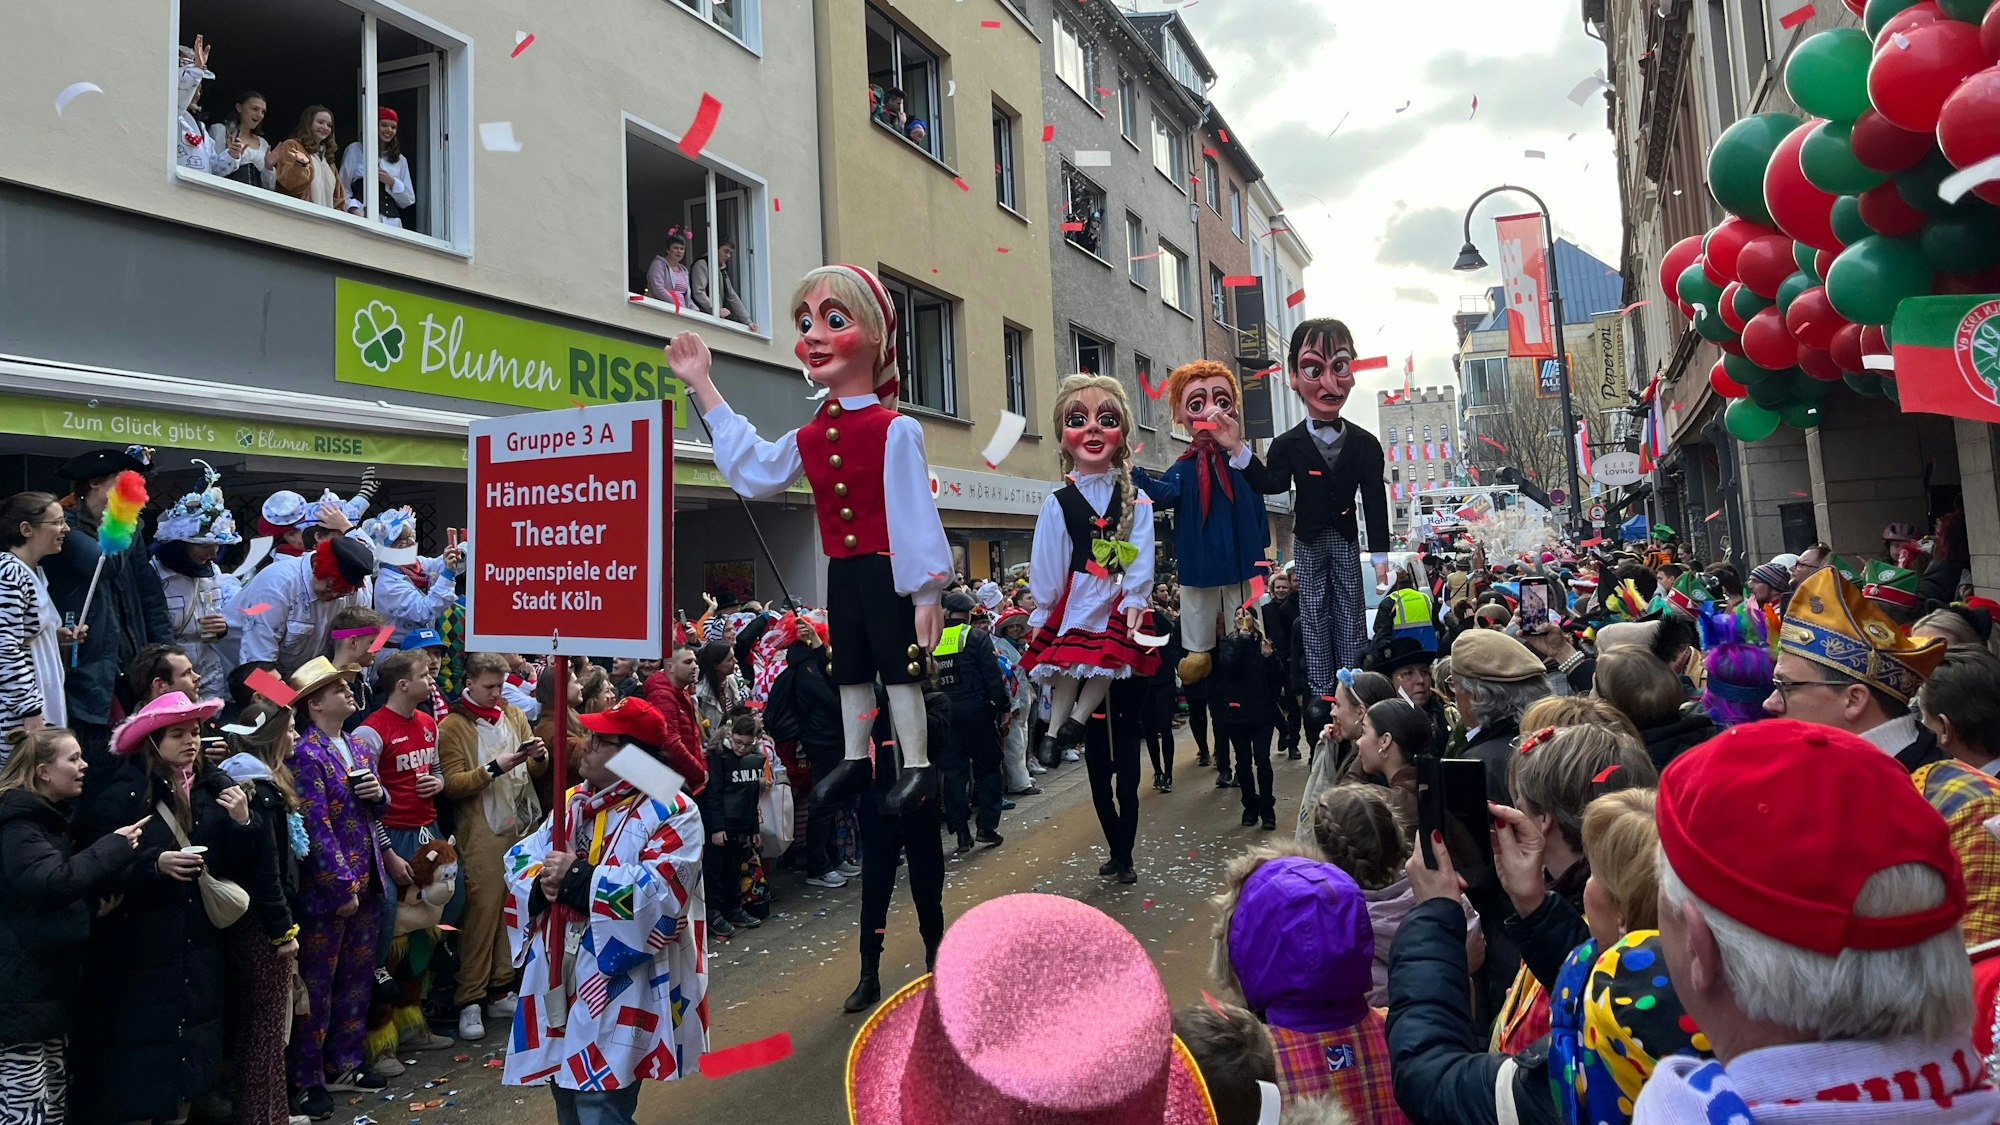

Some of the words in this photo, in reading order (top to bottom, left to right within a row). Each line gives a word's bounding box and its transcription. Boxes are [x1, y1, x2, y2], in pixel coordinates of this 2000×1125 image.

[418, 313, 562, 393] Blumen
[569, 347, 678, 411] RISSE
[1241, 322, 1263, 392] MUEL
[1597, 323, 1621, 401] Peperoni
[63, 411, 103, 432] Zum
[110, 415, 162, 438] Glück
[168, 425, 215, 443] gibt's
[507, 431, 576, 454] Gruppe
[582, 424, 593, 445] 3
[600, 423, 615, 444] A
[257, 429, 312, 453] Blumen
[314, 435, 363, 455] RISSE
[1604, 461, 1634, 469] KEEP
[1605, 468, 1634, 476] LOVING
[486, 474, 637, 508] Hänneschen
[511, 520, 607, 547] Theater
[485, 560, 600, 586] Puppenspiele
[605, 560, 637, 581] der
[512, 590, 557, 610] Stadt
[561, 590, 602, 611] Köln
[941, 675, 954, 685] 3T3
